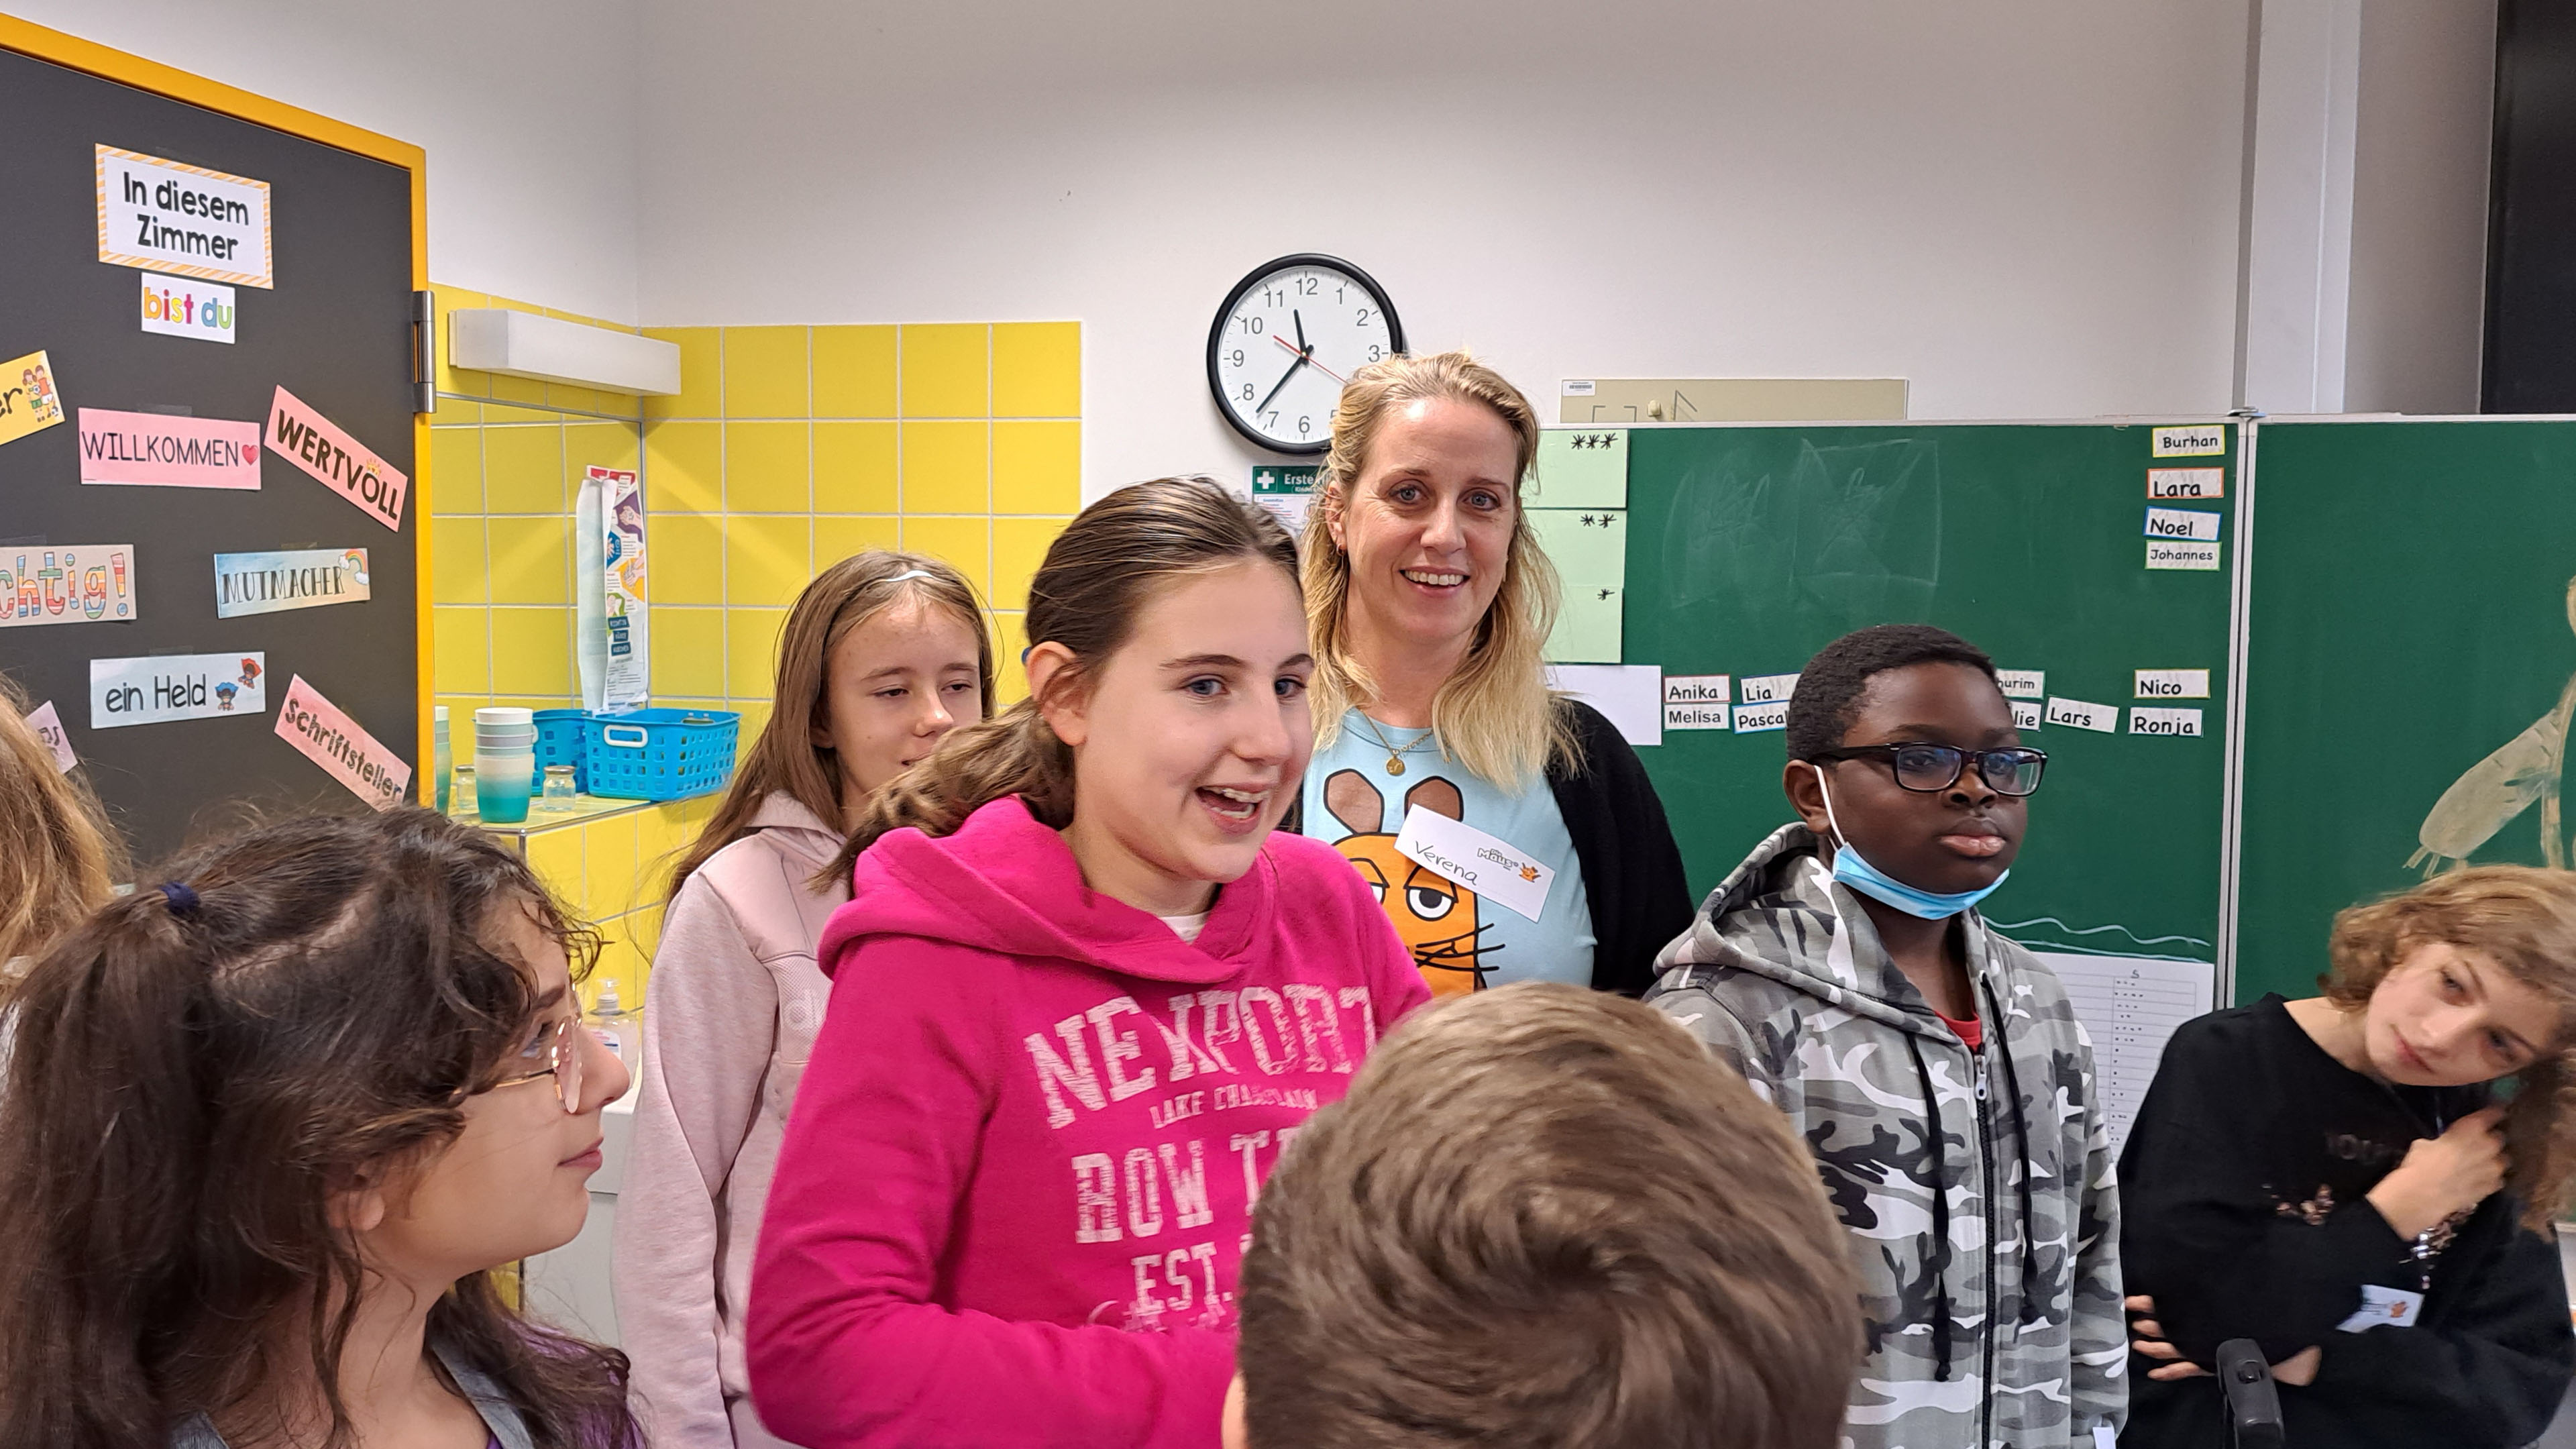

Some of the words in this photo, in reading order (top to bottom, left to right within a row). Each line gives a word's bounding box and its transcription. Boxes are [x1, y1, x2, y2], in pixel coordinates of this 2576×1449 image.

[123, 171, 147, 206] In
[156, 180, 249, 225] diesem
[137, 213, 239, 260] Zimmer
[1295, 278, 1318, 296] 12
[1264, 290, 1284, 308] 11
[1336, 288, 1343, 305] 1
[144, 286, 194, 325] bist
[201, 297, 232, 330] du
[1241, 317, 1263, 335] 10
[1356, 309, 1368, 327] 2
[1232, 350, 1244, 367] 9
[1368, 345, 1381, 363] 3
[1242, 383, 1254, 401] 8
[1268, 411, 1279, 428] 7
[1298, 415, 1310, 434] 6
[82, 431, 239, 468] WILLKOMMEN
[2163, 434, 2219, 449] Burhan
[277, 408, 398, 521] WERTVOLL
[1284, 473, 1314, 484] Erste
[2153, 480, 2202, 497] Lara
[2150, 518, 2194, 537] Noel
[2150, 549, 2214, 561] Johannes
[222, 566, 346, 605] MUTMACHER
[105, 681, 144, 712] ein
[154, 673, 207, 709] Held
[1668, 684, 1719, 700] Anika
[1746, 685, 1772, 701] Lia
[2140, 680, 2182, 695] Nico
[1668, 710, 1721, 724] Melisa
[2050, 707, 2092, 727] Lars
[2133, 716, 2194, 736] Ronja
[284, 698, 402, 802] Schriftsteller
[1415, 841, 1479, 885] Verena
[1477, 847, 1513, 867] Maus
[1148, 1090, 1205, 1129] LAKE
[1071, 1140, 1214, 1244] ROW
[1130, 1242, 1234, 1316] EST.
